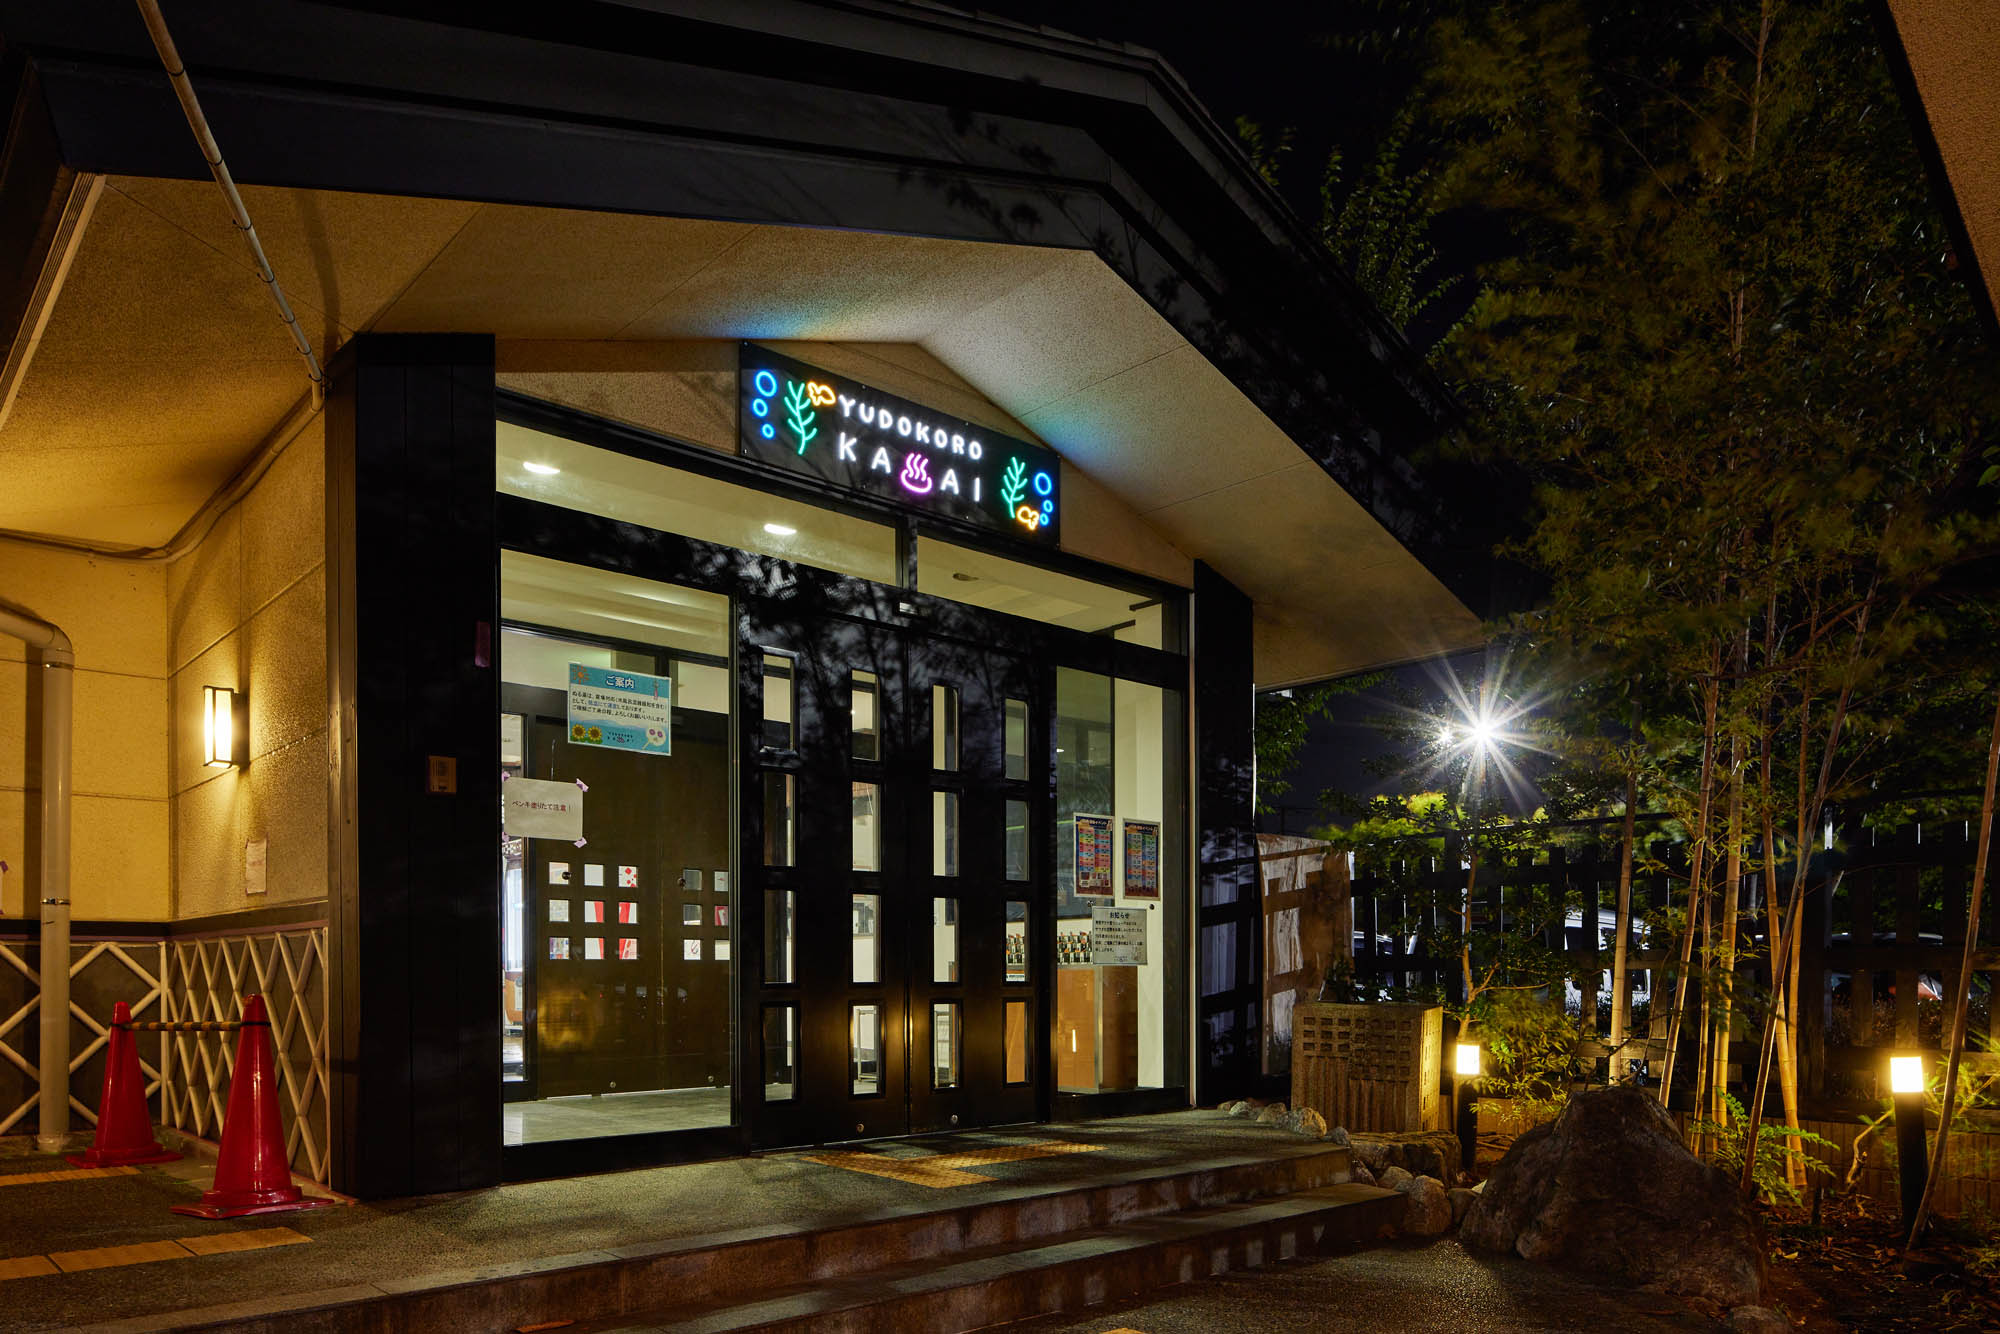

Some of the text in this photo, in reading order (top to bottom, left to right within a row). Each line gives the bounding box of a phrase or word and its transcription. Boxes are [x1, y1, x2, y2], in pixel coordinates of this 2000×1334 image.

[839, 394, 982, 460] YUDOKORO
[606, 675, 635, 689] ご案内
